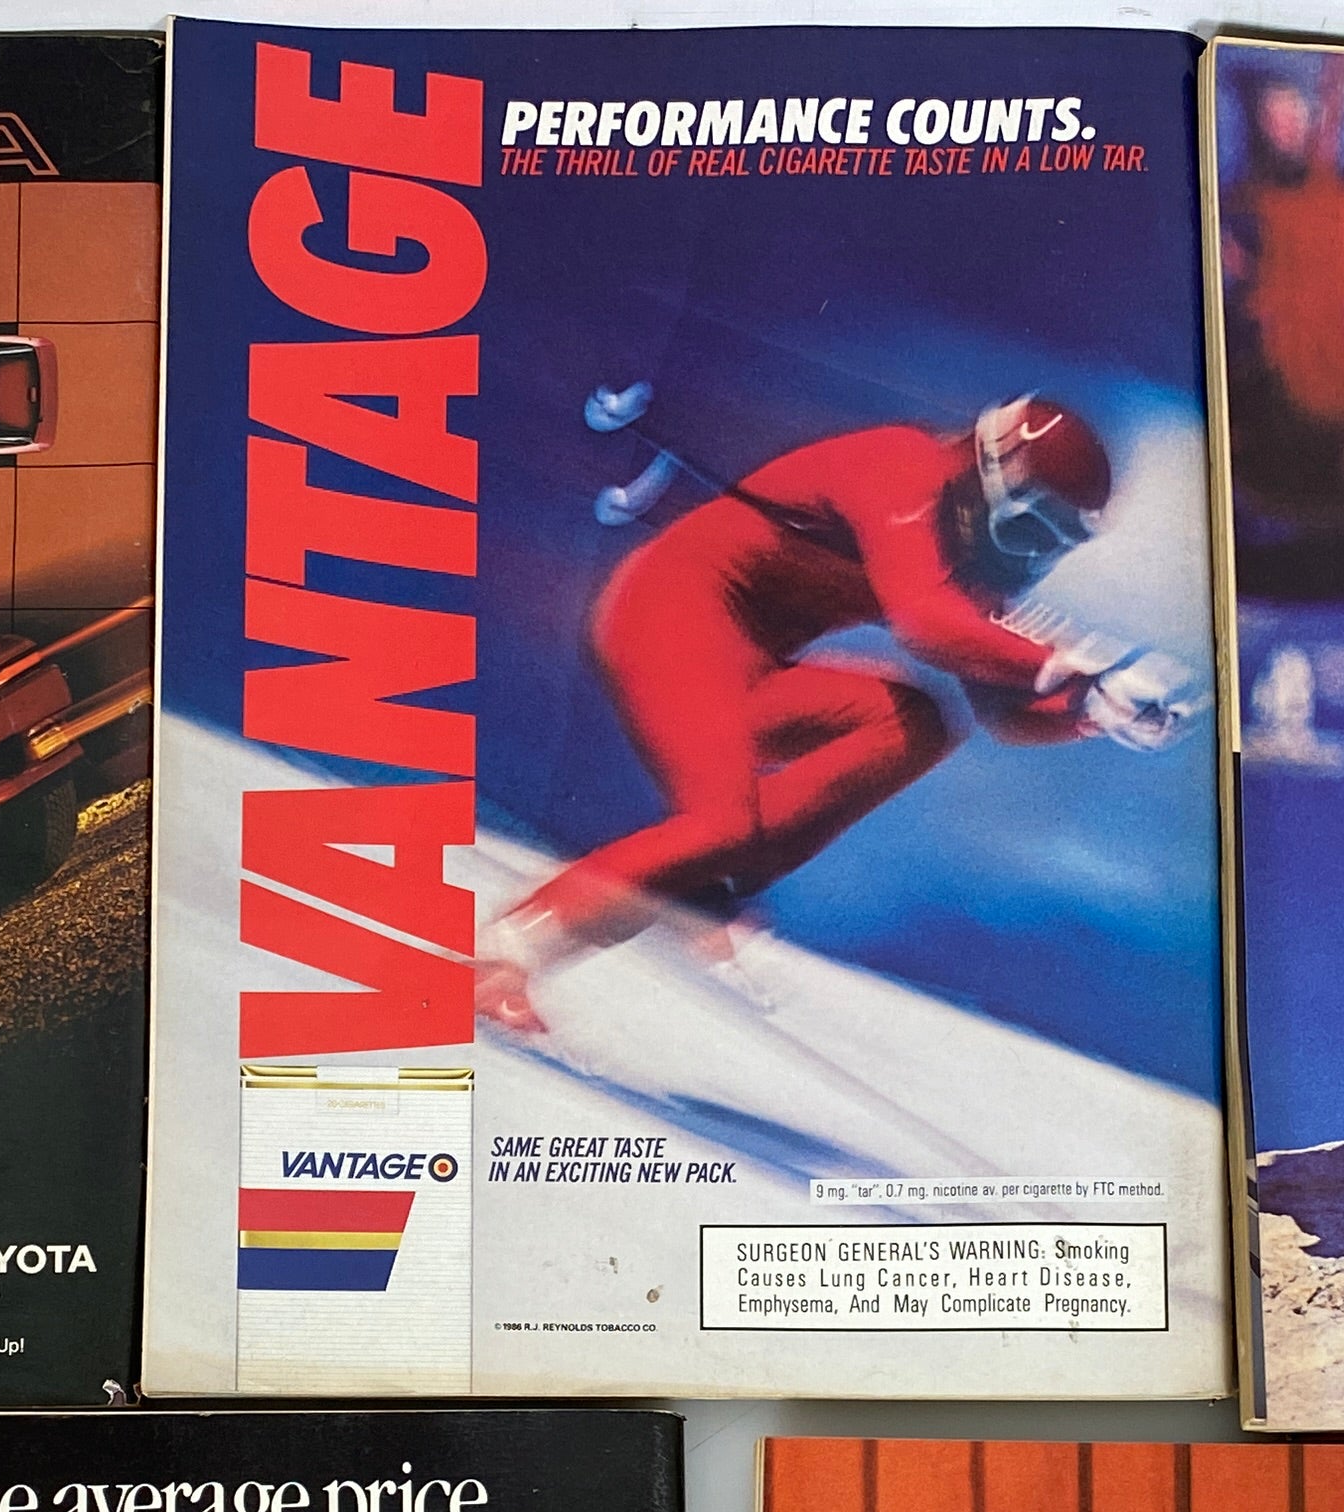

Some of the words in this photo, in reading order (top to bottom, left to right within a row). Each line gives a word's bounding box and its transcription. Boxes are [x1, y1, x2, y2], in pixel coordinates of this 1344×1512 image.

[502, 98, 873, 146] PERFORMANCE
[887, 97, 1095, 144] COUNTS.
[501, 148, 547, 175] THE
[556, 145, 642, 175] THRILL
[648, 148, 685, 176] OF
[691, 147, 749, 176] REAL
[759, 147, 896, 175] CIGARETTE
[905, 148, 974, 175] TASTE
[982, 147, 1009, 172] IN
[1015, 146, 1030, 171] A
[1040, 146, 1094, 171] LOW
[240, 42, 488, 1058] VANTAGE
[491, 1137, 544, 1157] SAME
[549, 1137, 609, 1157] GREAT
[614, 1138, 667, 1158] TASTE
[283, 1151, 427, 1179] VANTAGE
[489, 1162, 510, 1181] IN
[513, 1162, 541, 1182] AN
[545, 1162, 632, 1183] EXCITING
[637, 1163, 682, 1182] NEW
[686, 1163, 736, 1183] PACK.
[737, 1243, 825, 1262] SURGEON
[839, 1242, 939, 1261] GENERAL'S
[949, 1240, 1047, 1262] WARNING:
[1055, 1240, 1128, 1263] Smoking
[738, 1268, 805, 1287] Causes
[821, 1269, 864, 1291] Lung
[879, 1268, 956, 1288] Cancer,
[970, 1267, 1027, 1286] Heart
[1041, 1267, 1130, 1288] Disease,
[739, 1294, 838, 1316] Emphysema,
[850, 1294, 879, 1313] And
[895, 1294, 928, 1317] May
[942, 1293, 1030, 1316] Complicate
[1045, 1293, 1130, 1317] Pregnancy.
